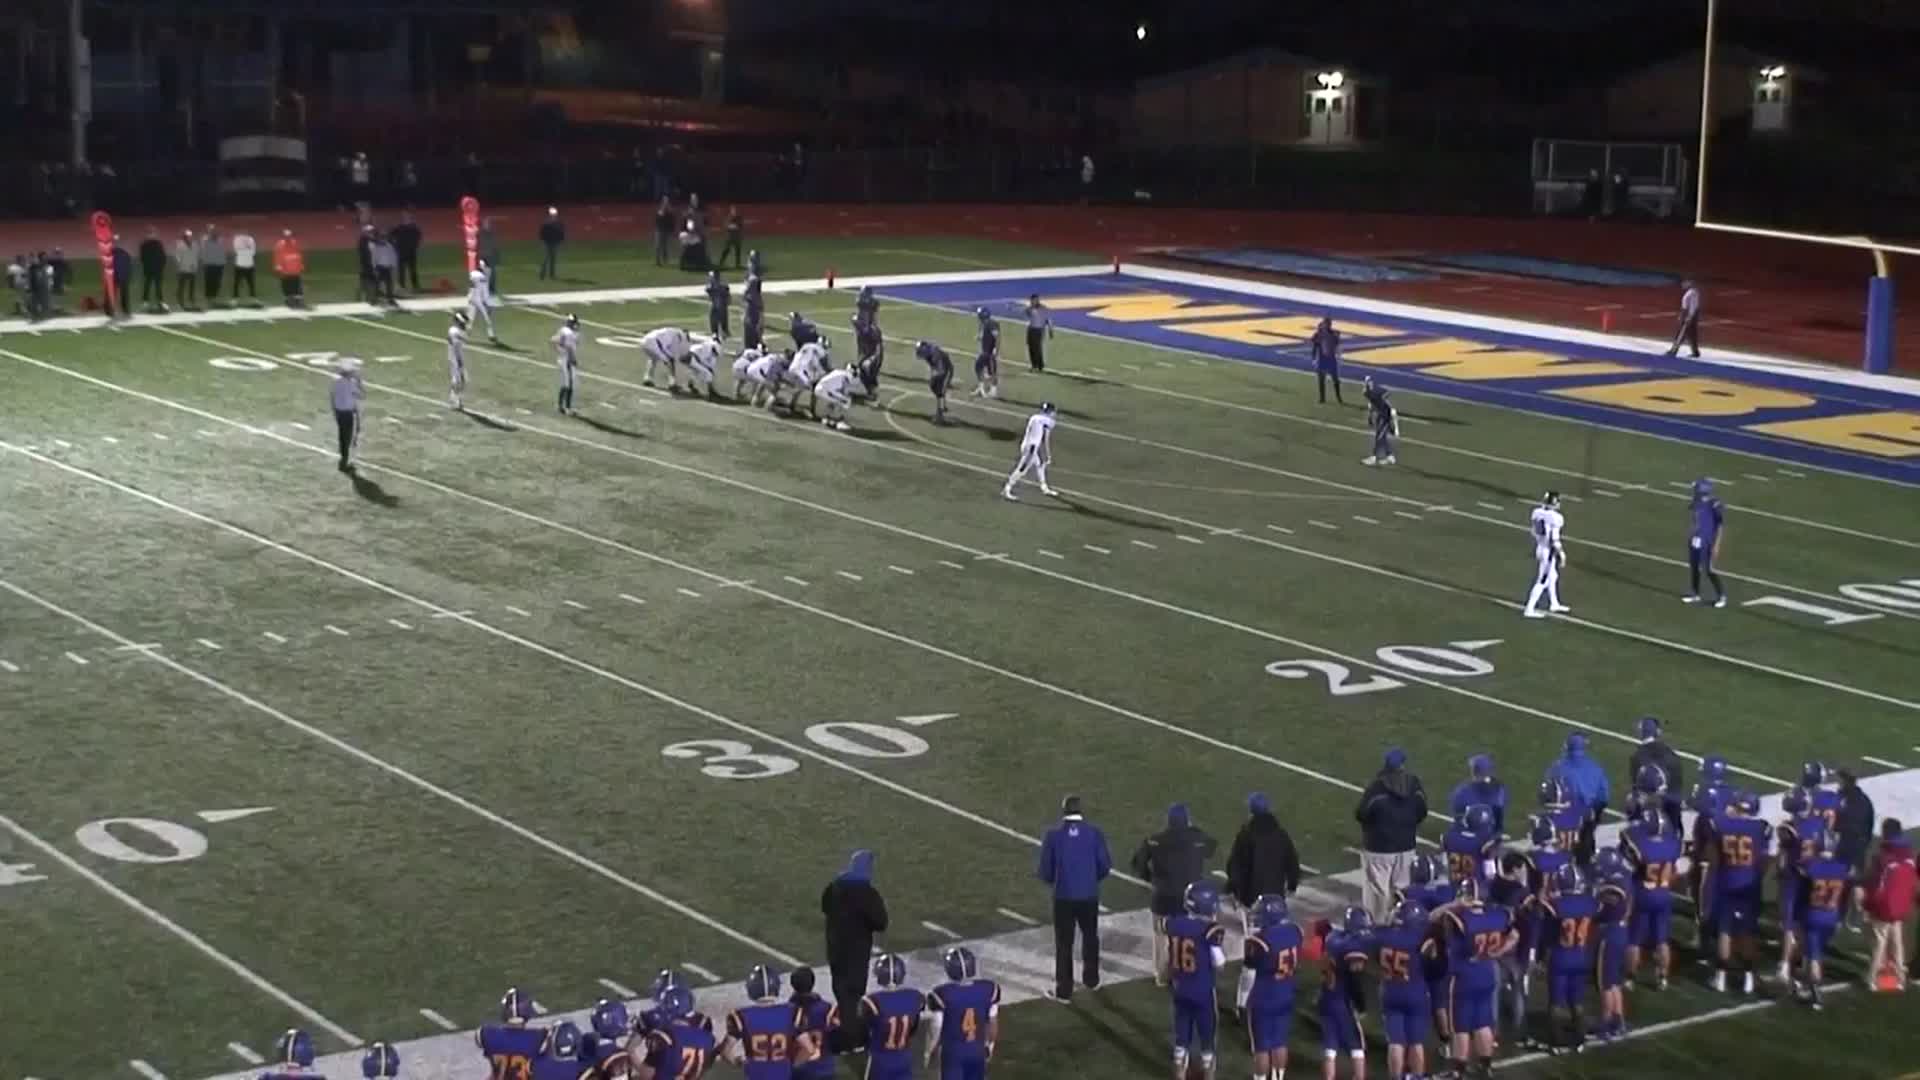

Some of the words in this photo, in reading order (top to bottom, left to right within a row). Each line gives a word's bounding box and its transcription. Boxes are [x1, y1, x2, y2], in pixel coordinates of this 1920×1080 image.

[1264, 645, 1495, 695] 20
[662, 722, 930, 779] 30
[1171, 935, 1196, 973] 16
[885, 1014, 909, 1049] 11
[961, 1008, 976, 1041] 4
[751, 1034, 788, 1062] 52
